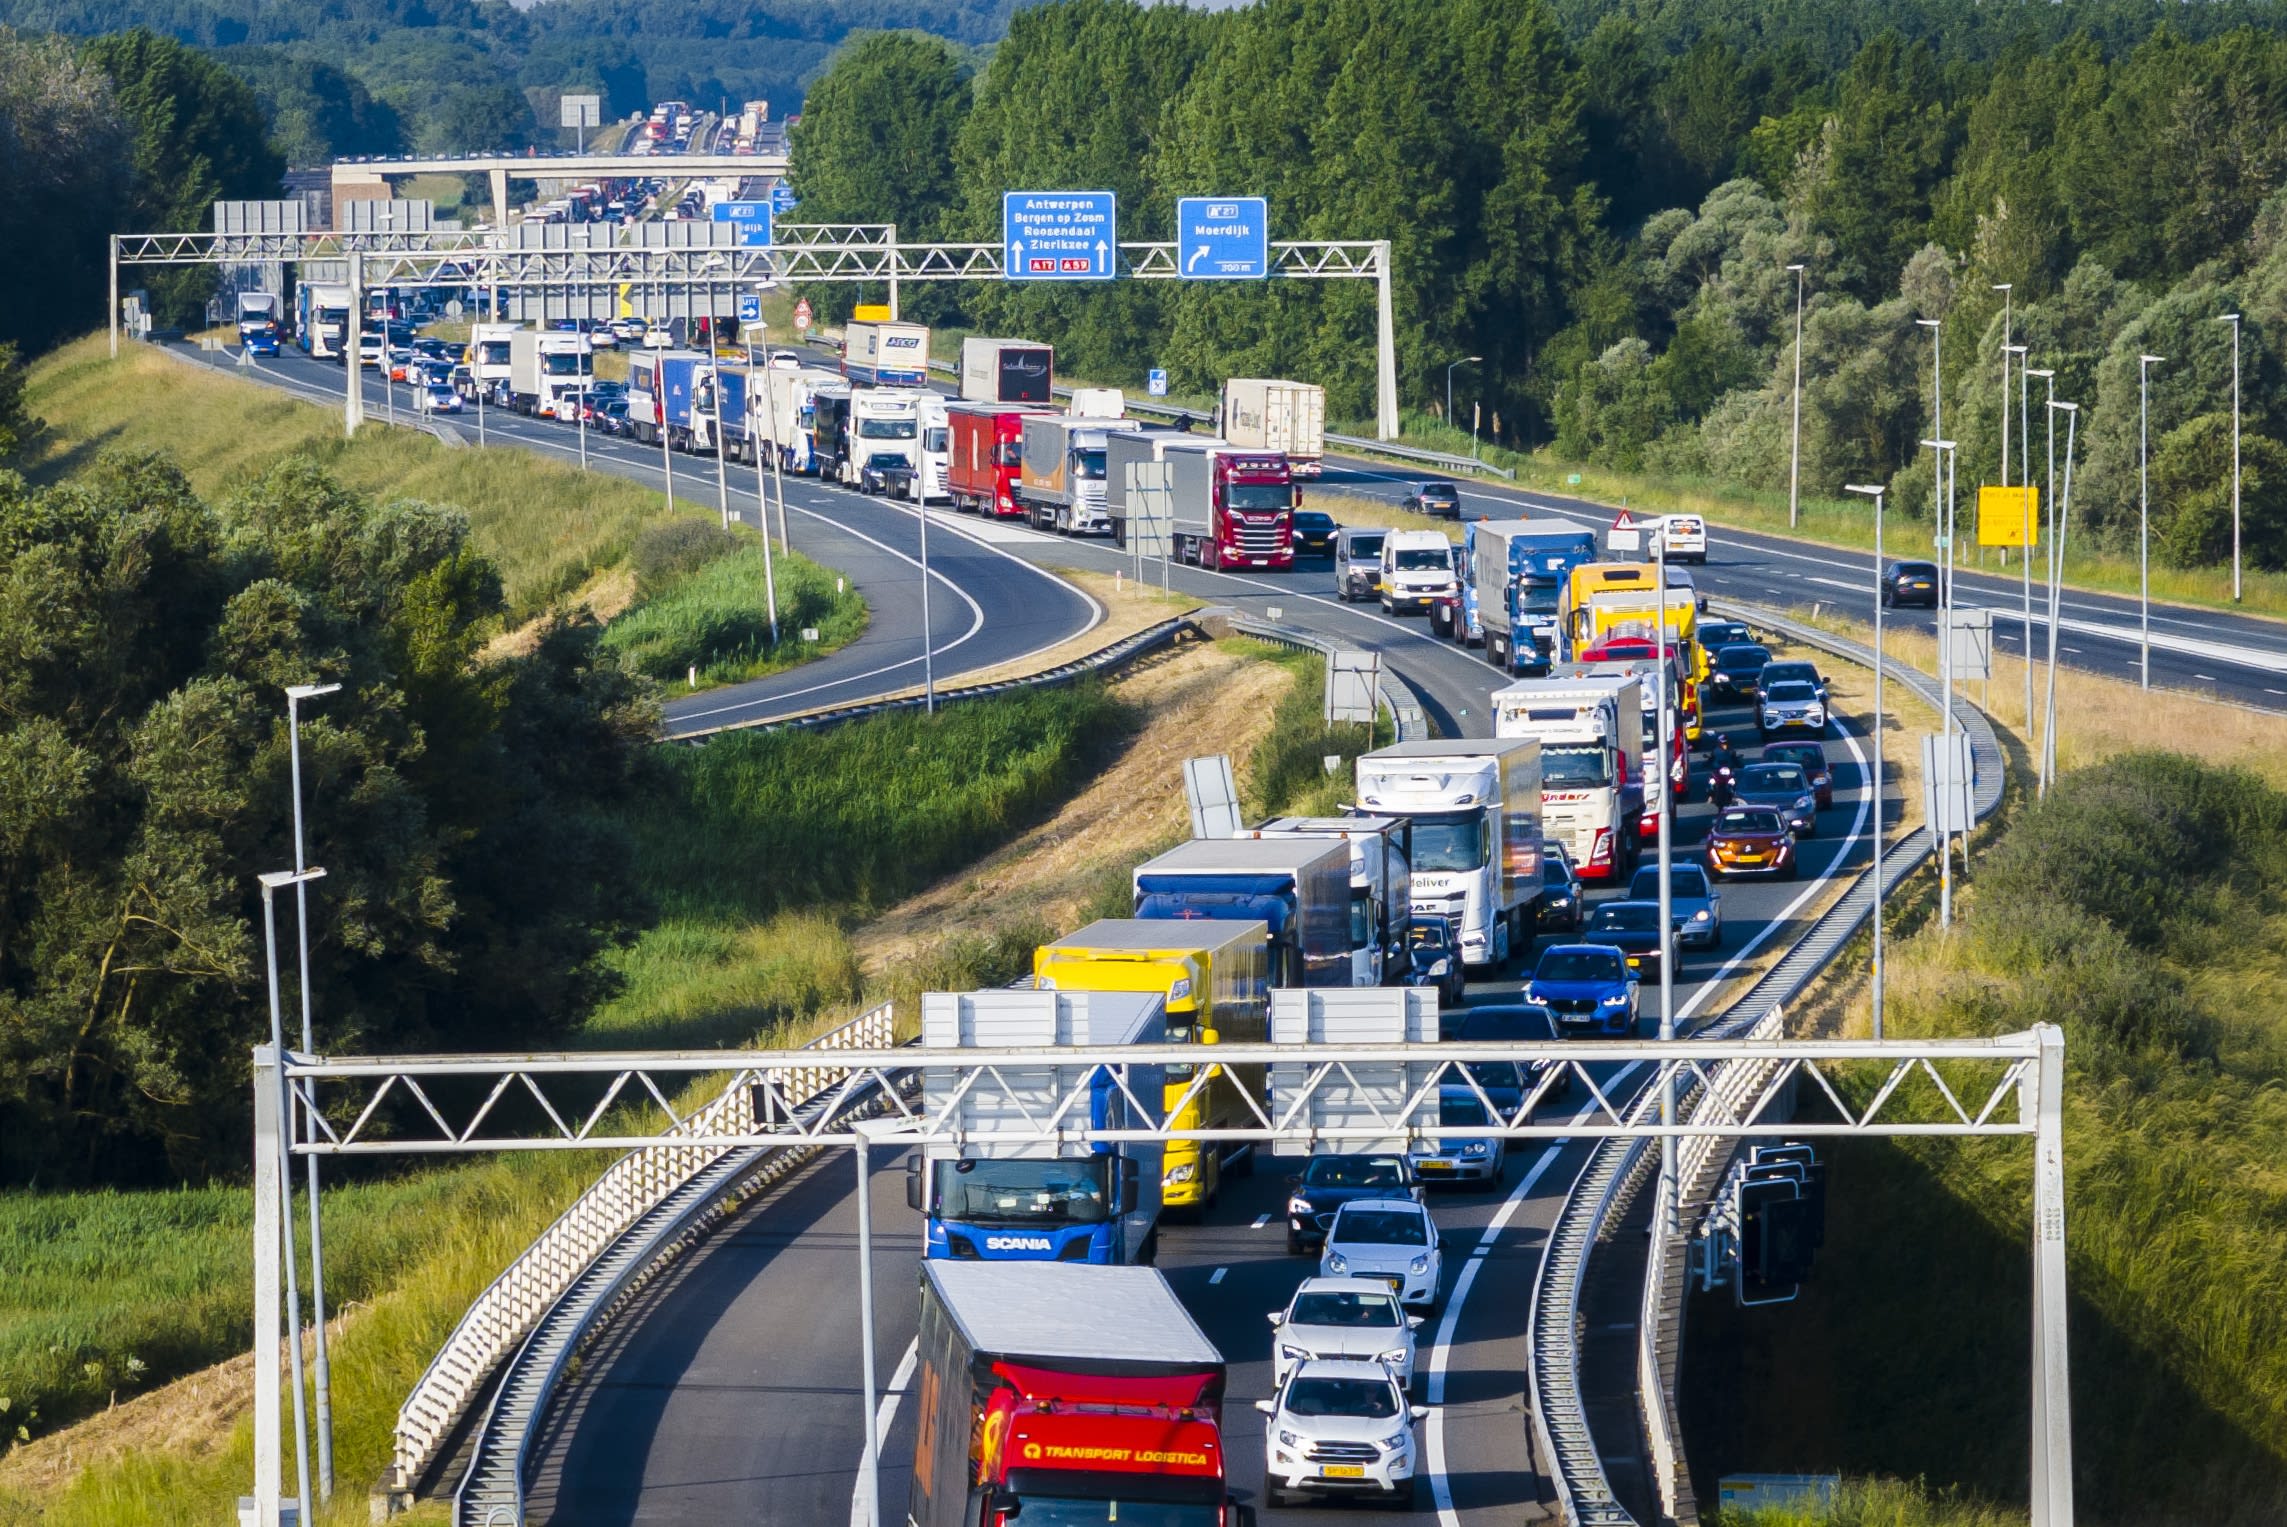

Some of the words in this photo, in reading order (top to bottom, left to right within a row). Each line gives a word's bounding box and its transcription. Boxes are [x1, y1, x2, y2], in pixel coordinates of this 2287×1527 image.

[1026, 199, 1093, 210] Antwerpen
[1015, 213, 1054, 224] Bergen
[1057, 215, 1071, 224] op
[1074, 212, 1105, 222] Zoom
[1024, 226, 1096, 236] Roosendaal
[1195, 225, 1249, 238] Moerdijk
[1030, 239, 1089, 250] Zierikzee
[1032, 261, 1053, 270] A17
[986, 1237, 1052, 1250] SCANIA
[1045, 1446, 1131, 1461] TRANSPORT
[1133, 1450, 1208, 1466] LOGISTICA
